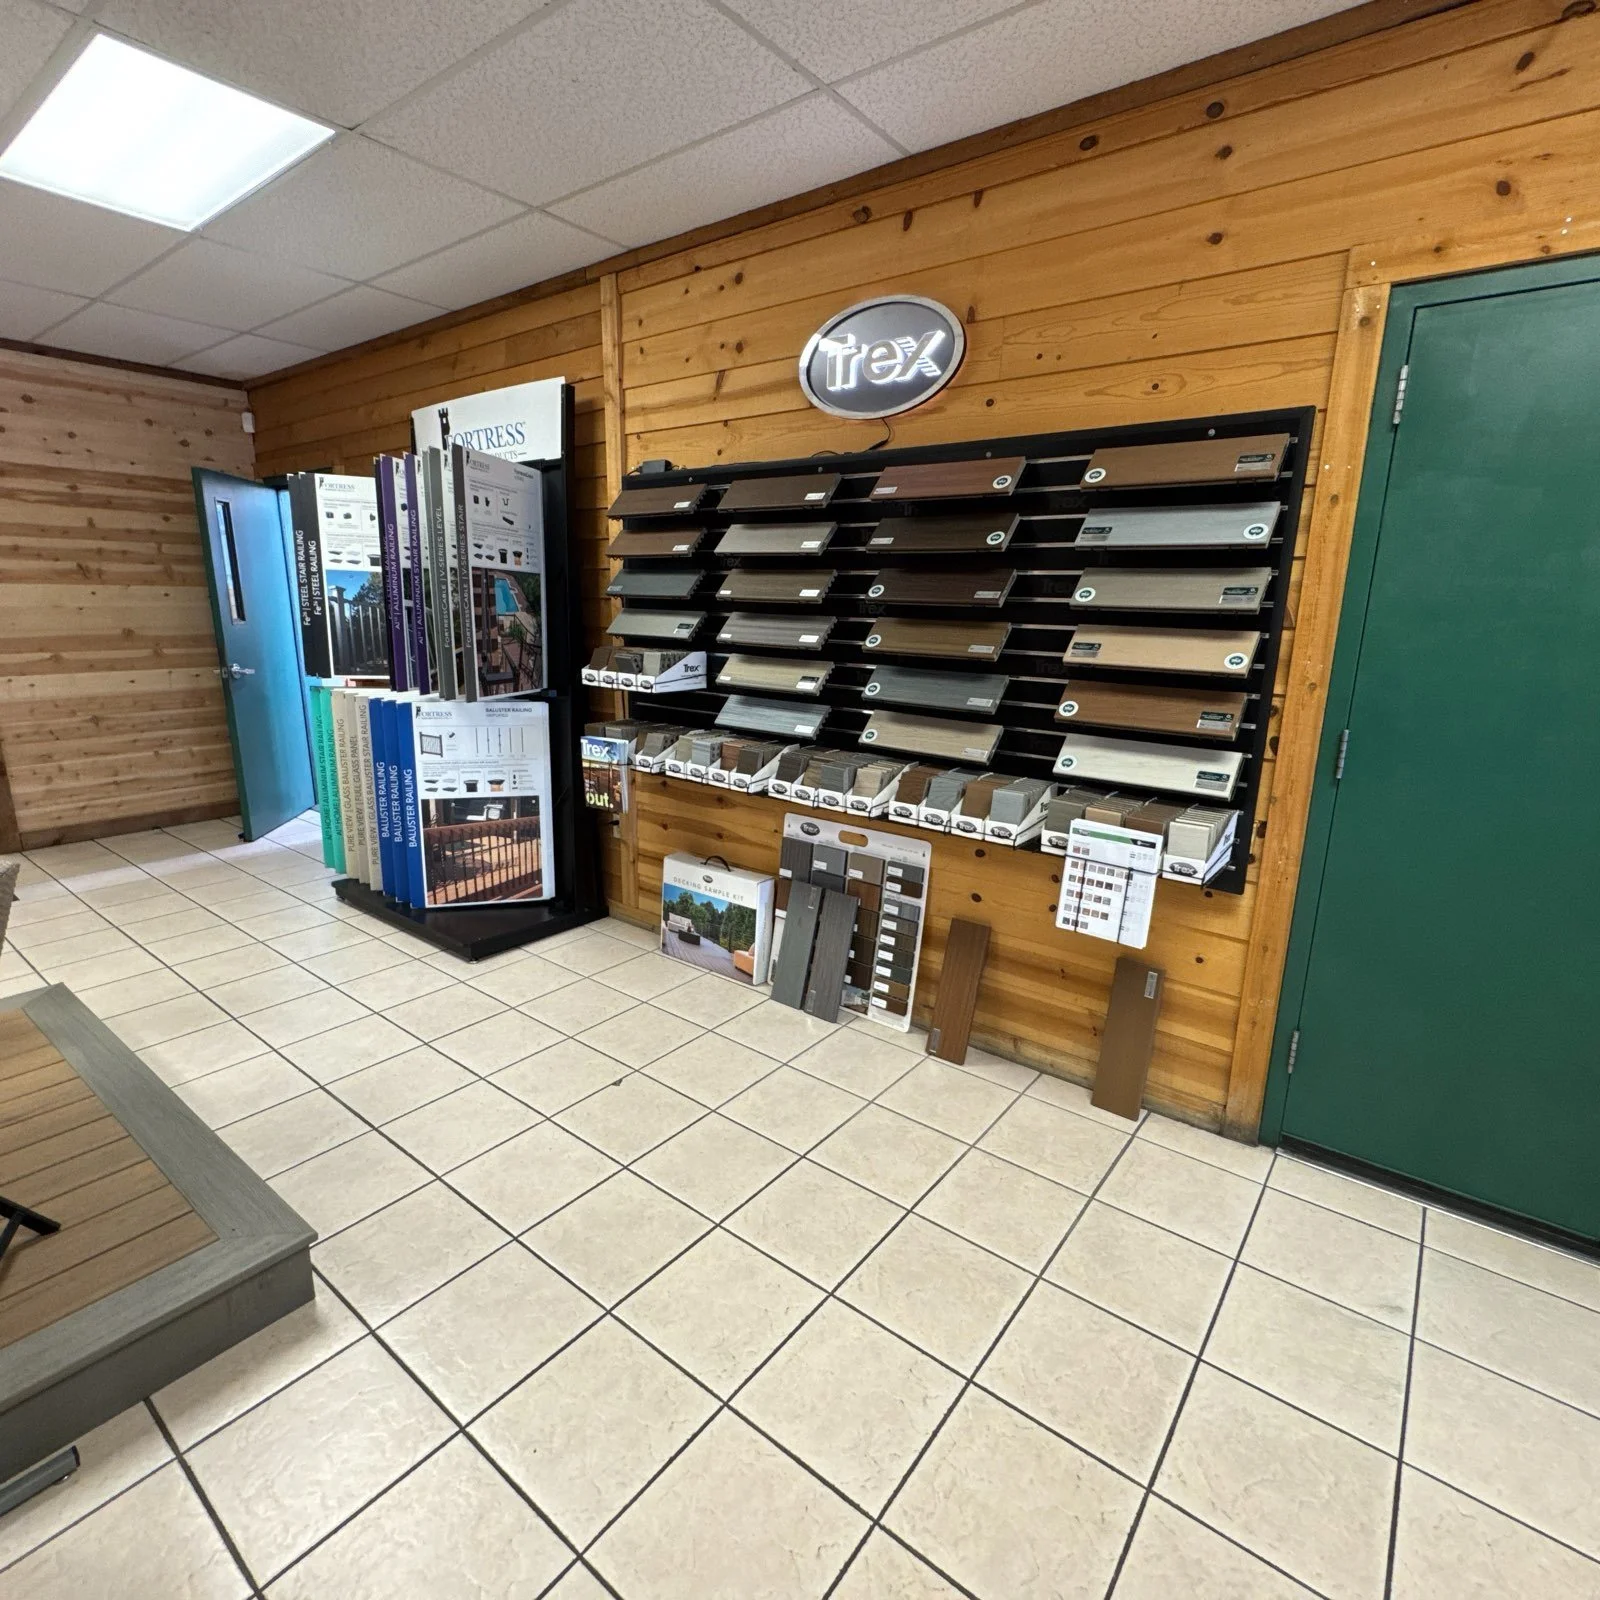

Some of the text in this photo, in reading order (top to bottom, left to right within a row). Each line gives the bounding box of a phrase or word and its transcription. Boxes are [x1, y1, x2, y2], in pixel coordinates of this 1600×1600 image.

[818, 329, 945, 392] Trex
[410, 510, 418, 547] RAILING
[435, 506, 443, 535] LEVEL
[457, 504, 465, 532] STAIR
[295, 530, 306, 562] RAILING
[387, 523, 396, 560] RAILING
[308, 540, 319, 571] RAILING
[412, 549, 420, 574] STAIR
[299, 564, 308, 584] STAIR
[311, 572, 321, 596] STEEL
[300, 586, 310, 606] STEEL
[391, 562, 400, 611] ALUMINUM
[414, 575, 422, 626] ALUMINUM
[683, 664, 700, 673] Trex
[358, 704, 368, 735] RAILING
[336, 718, 346, 748] RAILING
[349, 735, 358, 758] PANEL
[361, 736, 370, 757] STAIR
[580, 739, 610, 758] Trex
[339, 750, 350, 785] BALUSTER
[351, 759, 361, 783] GLASS
[362, 758, 374, 795] BALUSTER
[342, 786, 351, 809] GLASS
[365, 796, 375, 820] GLASS
[376, 762, 390, 838] BALUSTER RAILING
[388, 765, 403, 842] BALUSTER RAILING
[403, 768, 418, 848] BALUSTER RAILING
[586, 792, 614, 809] out.
[345, 815, 353, 833] VIEW
[356, 807, 364, 825] VIEW
[926, 814, 944, 825] Trex
[957, 821, 976, 832] Trex
[357, 827, 366, 846] PURE
[368, 826, 377, 845] VIEW
[802, 823, 818, 834] Trex
[992, 827, 1012, 838] Trex
[347, 834, 355, 852] PURE
[370, 846, 379, 865] PURE
[1173, 864, 1195, 874] Trex
[673, 876, 744, 902] DECKING SAMPLE KIT
